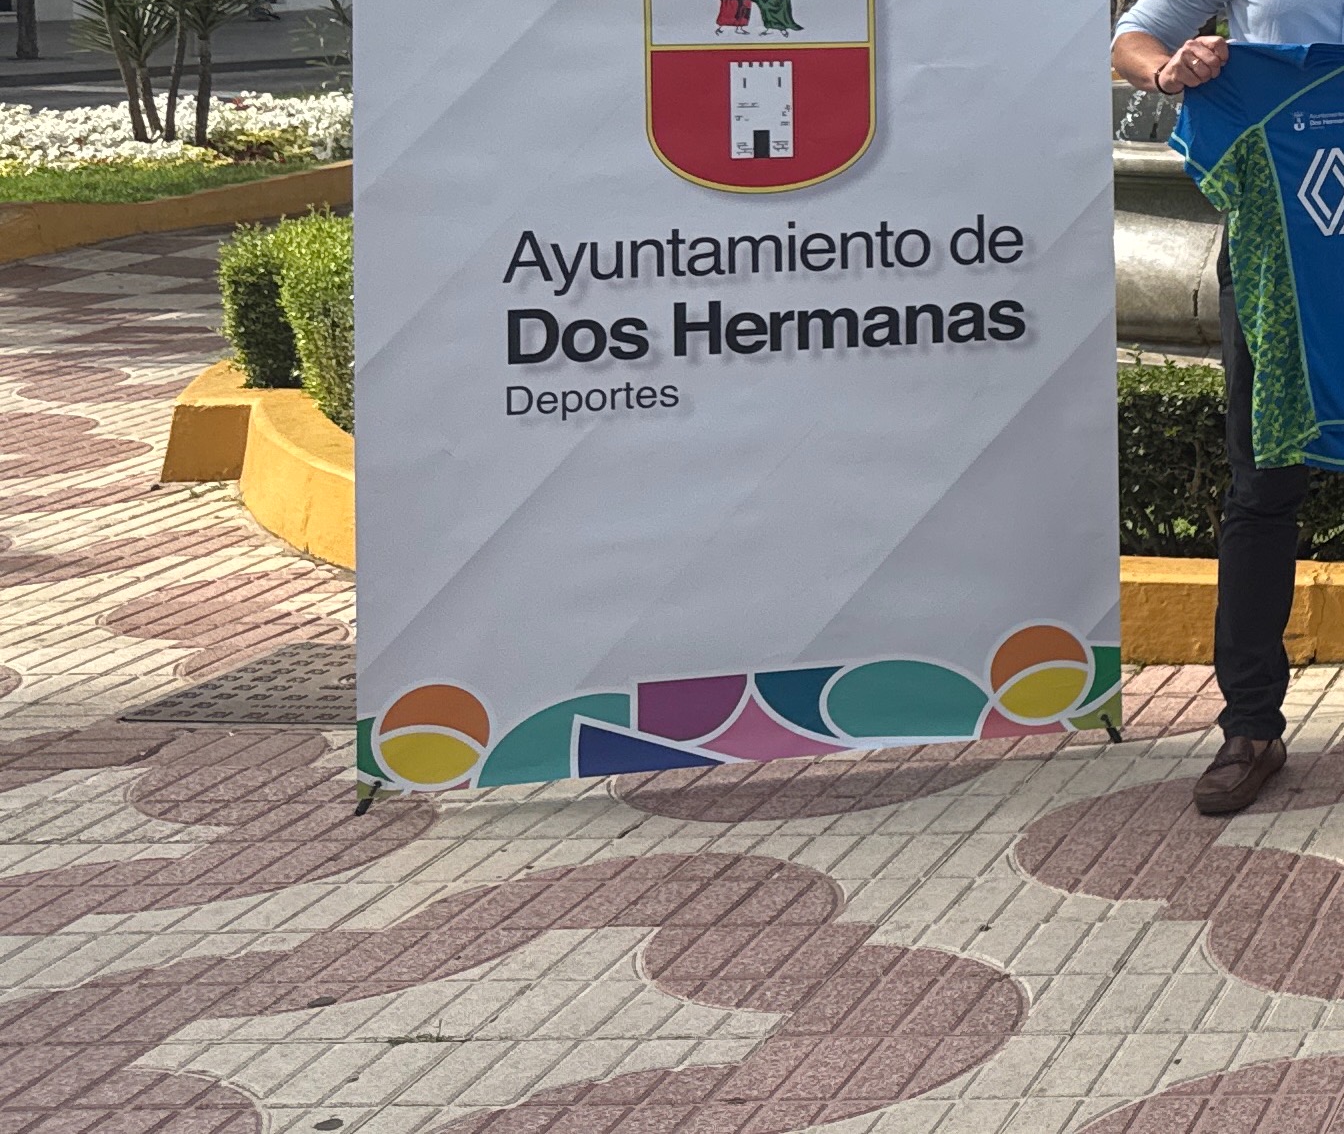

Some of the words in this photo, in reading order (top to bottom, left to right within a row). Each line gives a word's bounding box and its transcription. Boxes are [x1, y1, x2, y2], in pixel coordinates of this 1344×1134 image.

[502, 221, 932, 297] Ayuntamiento
[949, 214, 1025, 264] de
[506, 308, 650, 365] Dos
[673, 298, 1027, 357] Hermanas
[505, 380, 680, 420] Deportes
